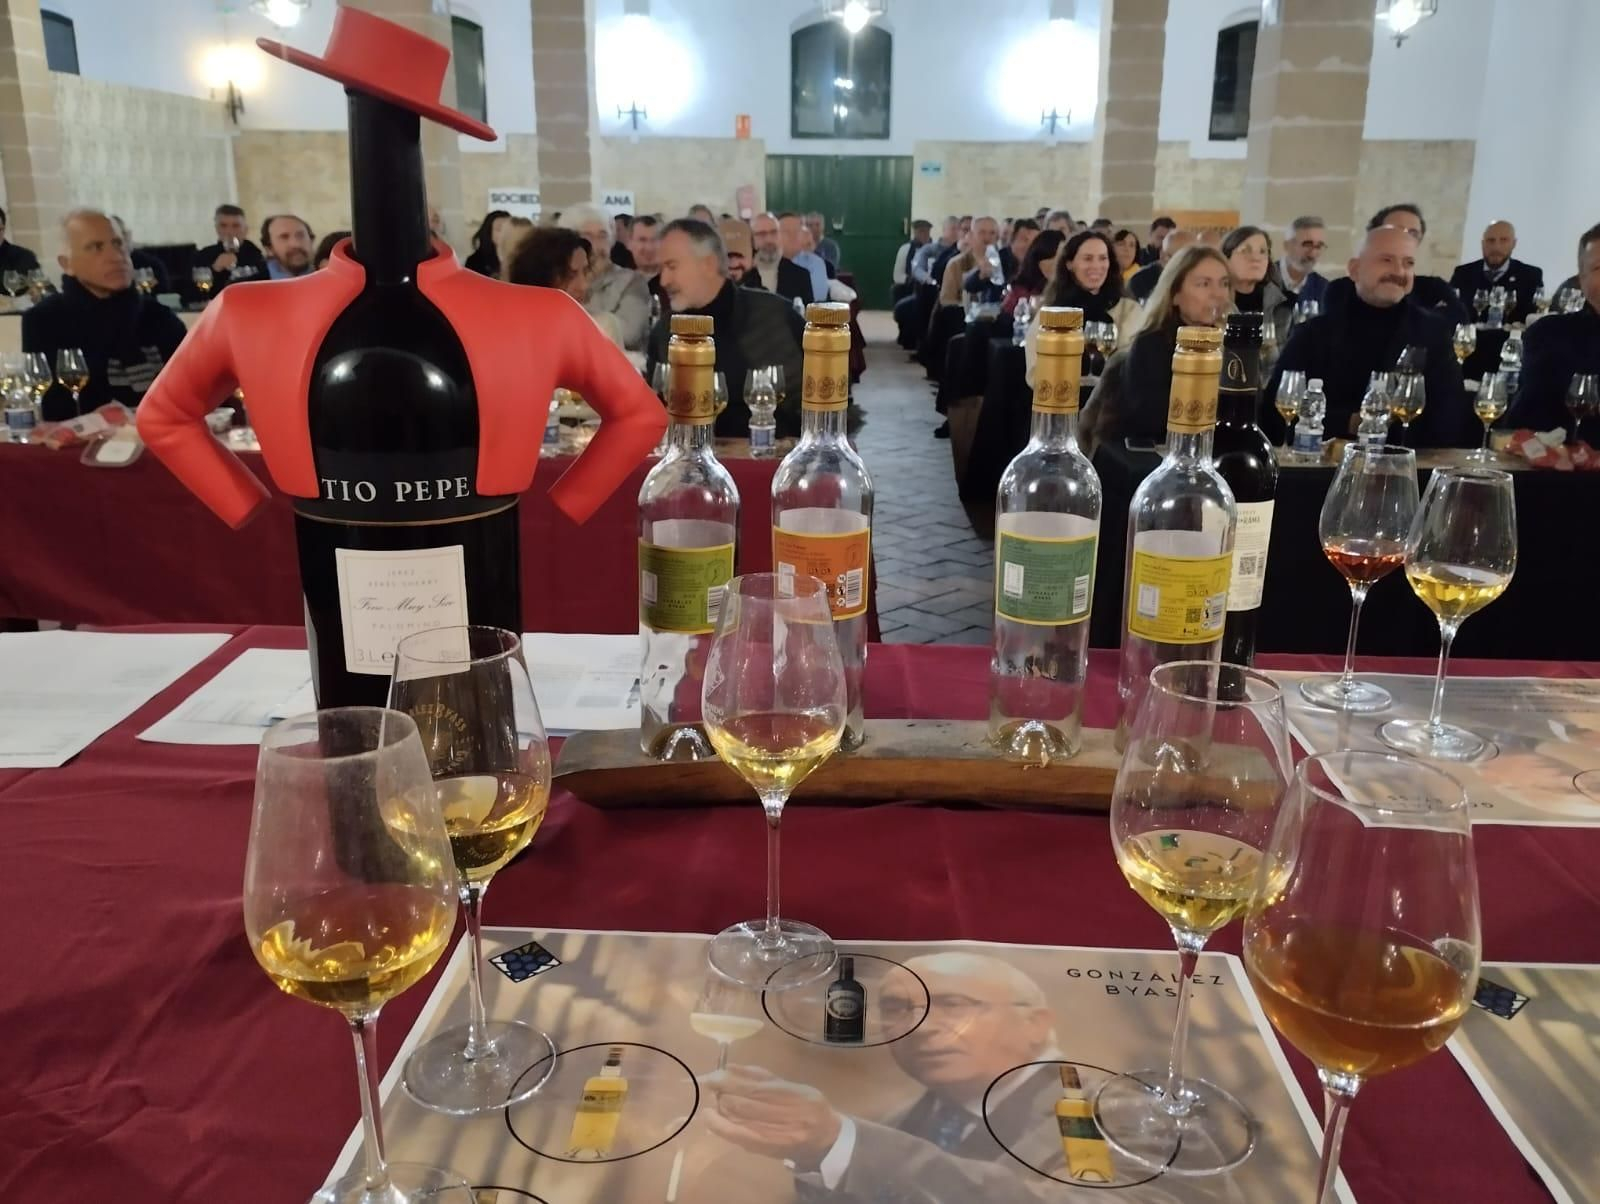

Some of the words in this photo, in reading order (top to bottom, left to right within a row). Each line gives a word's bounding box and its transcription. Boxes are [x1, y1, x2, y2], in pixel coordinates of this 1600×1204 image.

[321, 478, 377, 502] TIO
[394, 476, 470, 502] PEPE
[1105, 985, 1194, 998] BYAS
